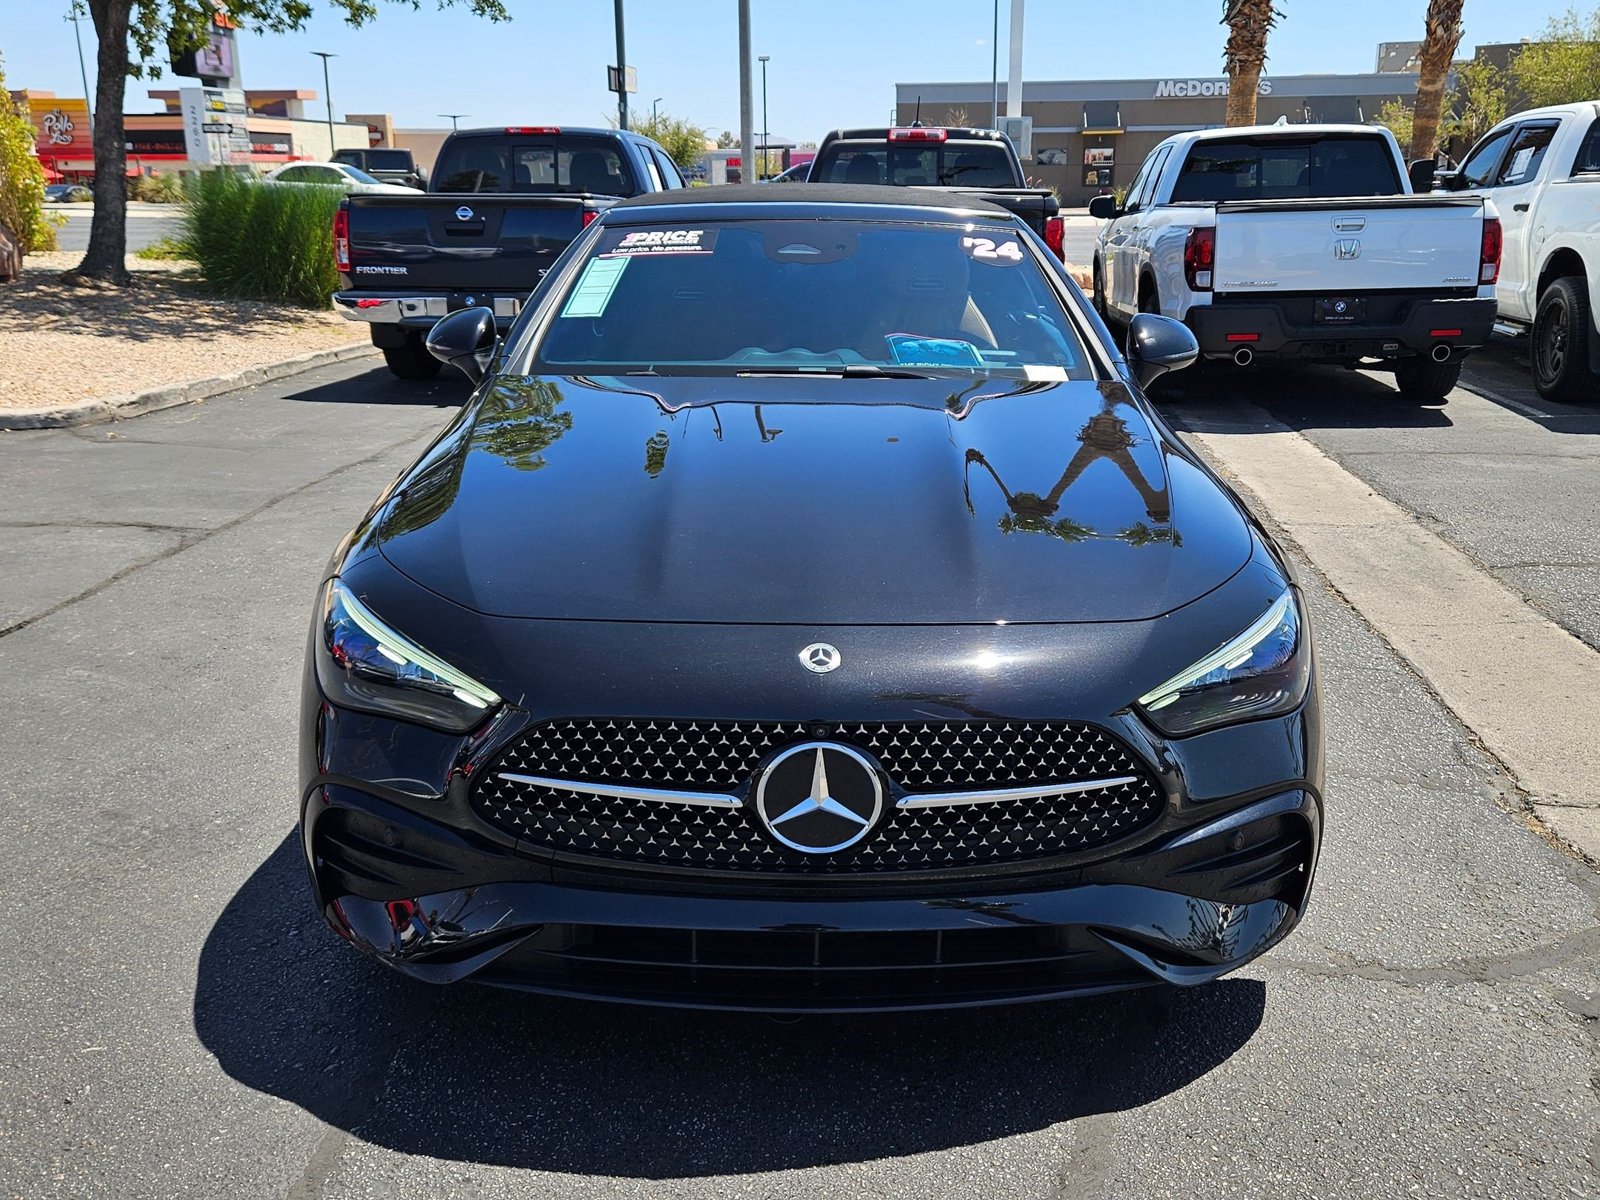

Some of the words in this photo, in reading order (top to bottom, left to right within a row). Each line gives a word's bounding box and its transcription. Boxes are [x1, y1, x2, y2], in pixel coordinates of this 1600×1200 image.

[1155, 79, 1273, 97] McDon's
[44, 113, 74, 134] Pollo
[356, 266, 408, 275] FRONTIER
